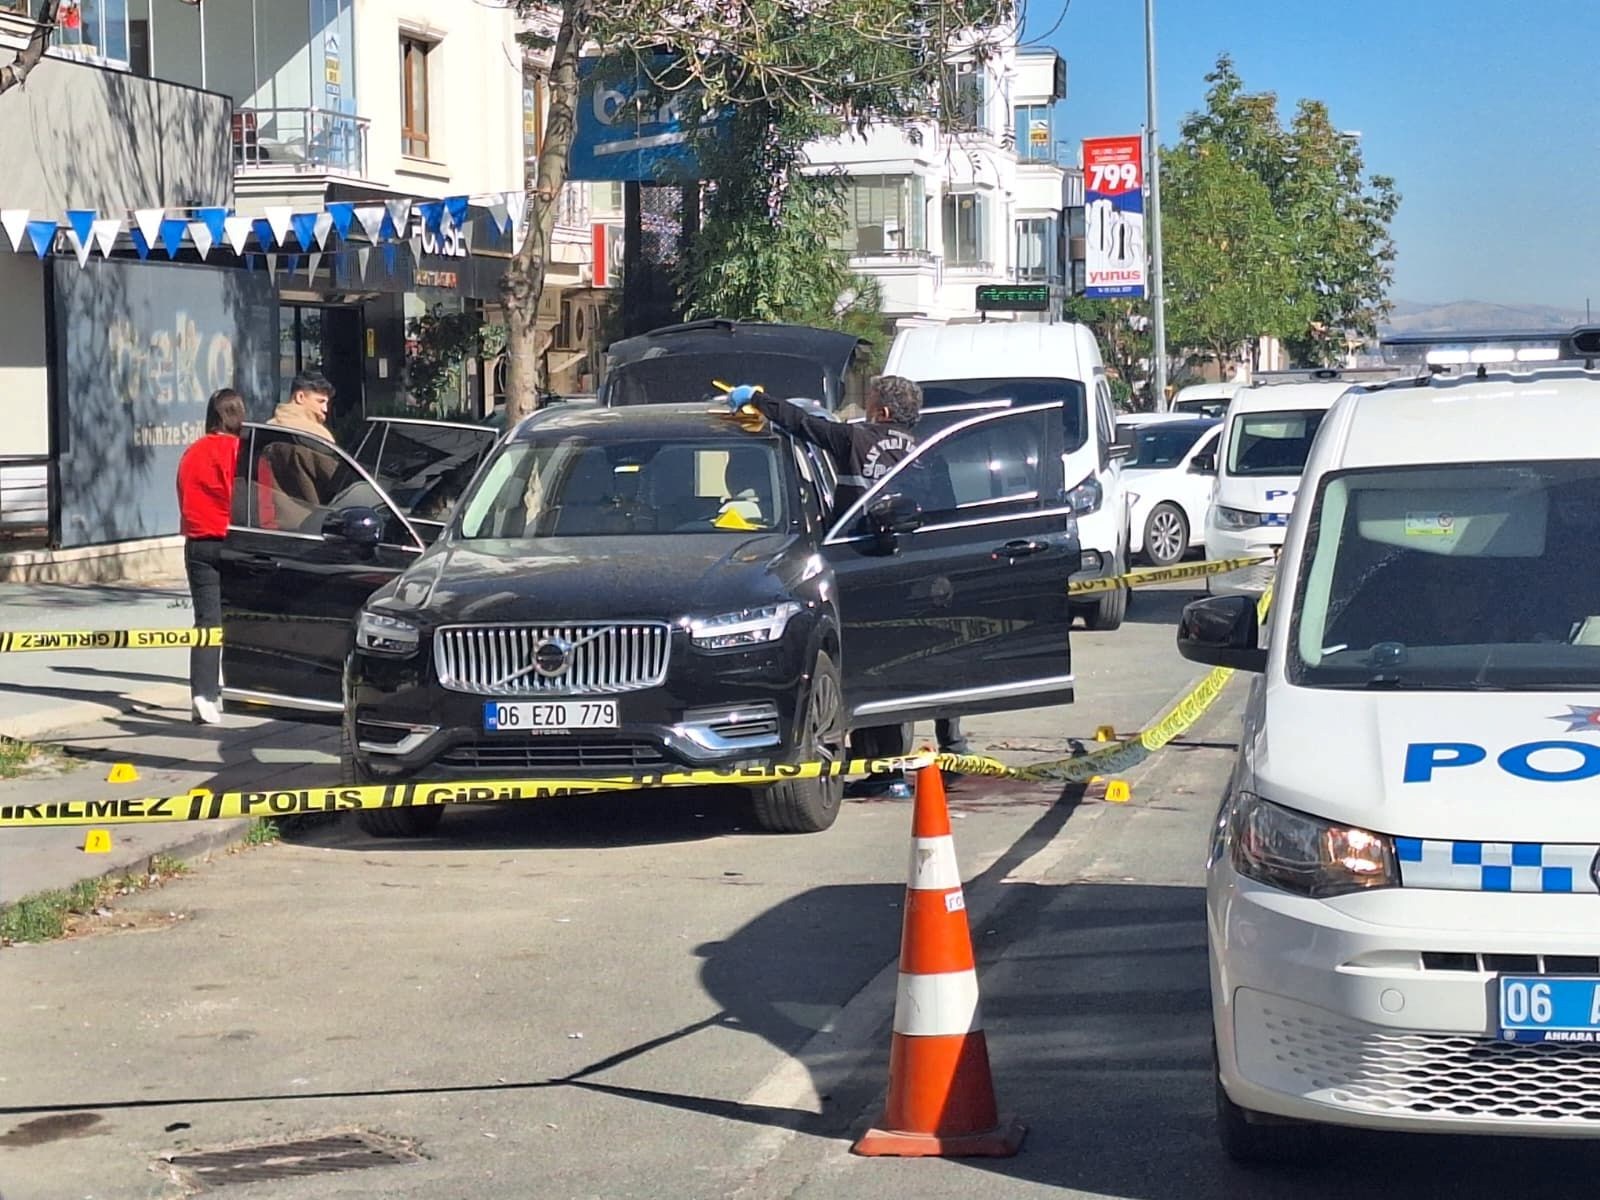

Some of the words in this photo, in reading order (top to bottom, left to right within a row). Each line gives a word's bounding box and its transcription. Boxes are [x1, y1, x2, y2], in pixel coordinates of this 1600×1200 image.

[1090, 163, 1137, 190] 799
[1089, 270, 1141, 284] yunus
[498, 706, 519, 726] 06
[533, 704, 566, 726] EZD
[580, 704, 614, 724] 779
[1507, 982, 1552, 1023] 06
[1544, 1031, 1593, 1042] ANKARA
